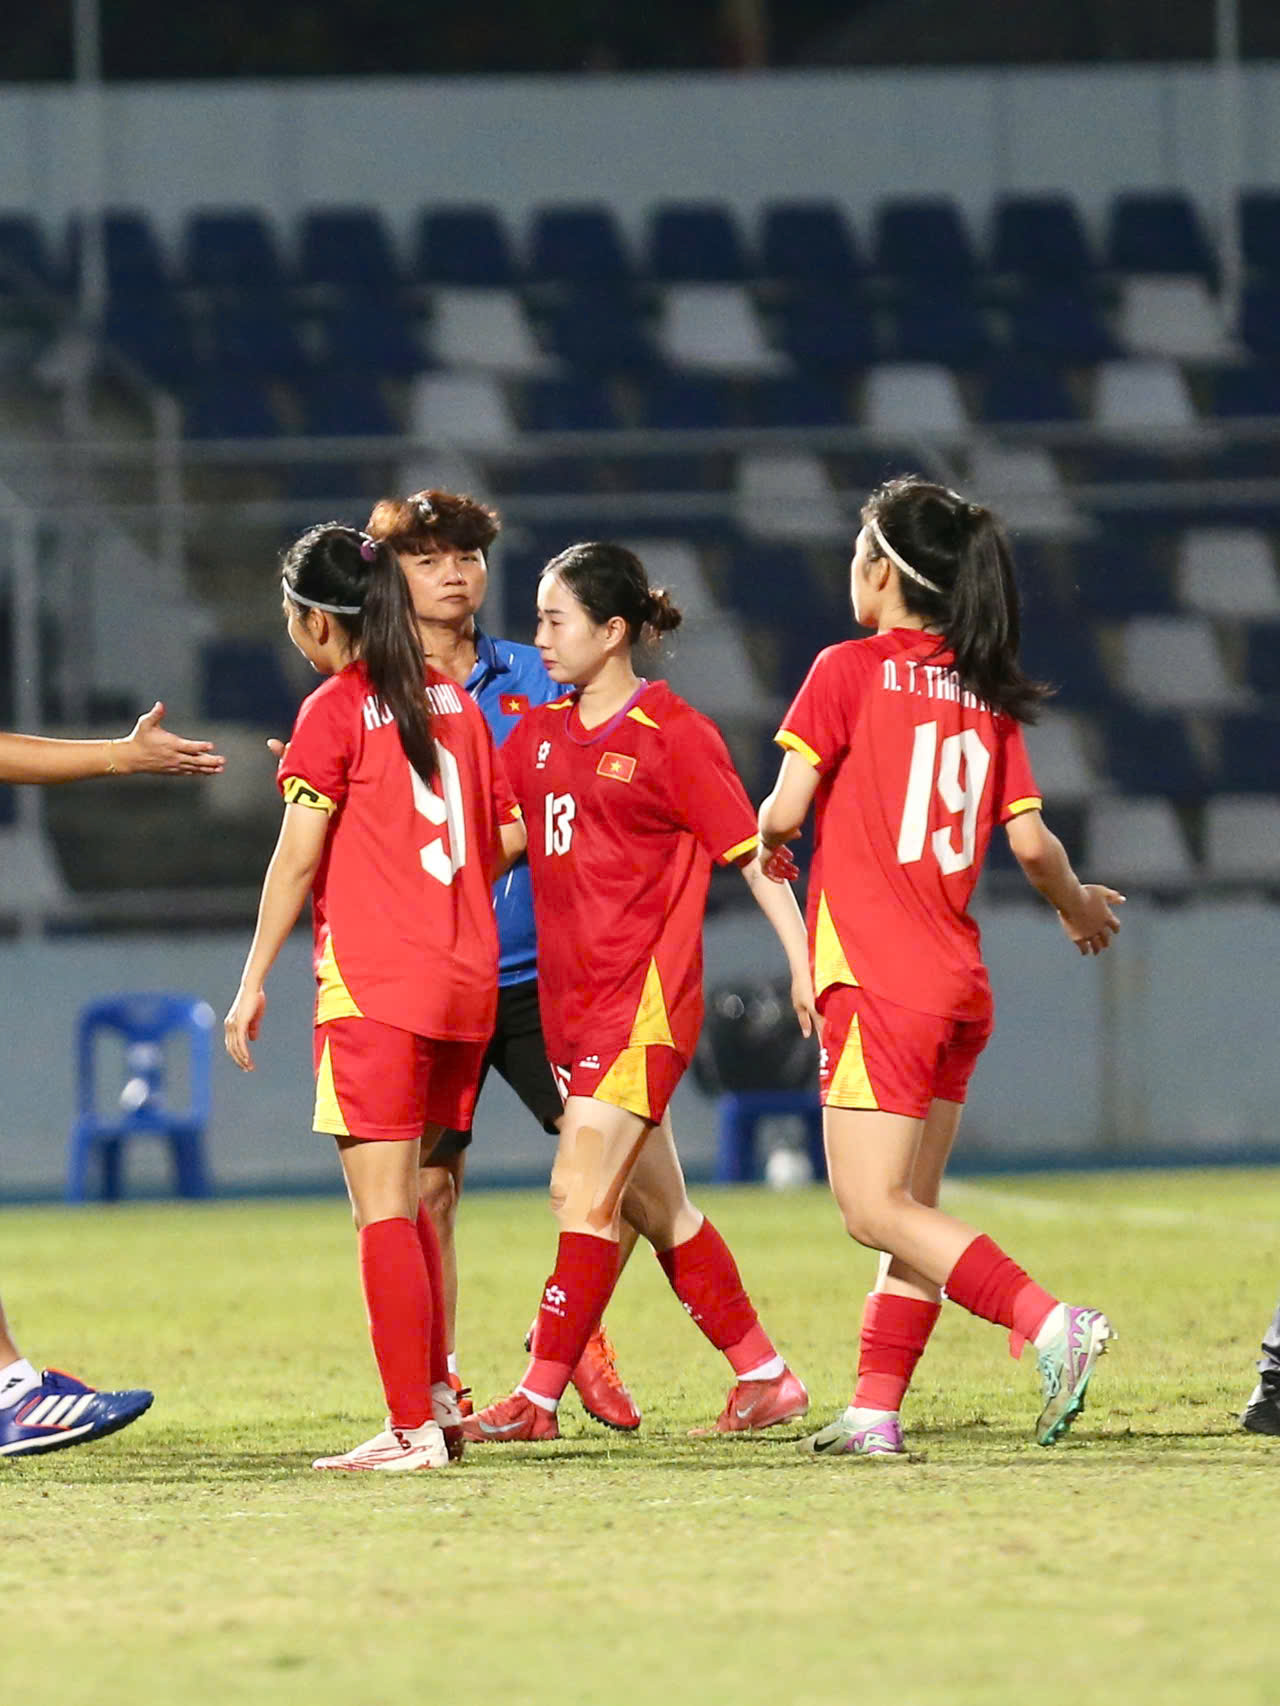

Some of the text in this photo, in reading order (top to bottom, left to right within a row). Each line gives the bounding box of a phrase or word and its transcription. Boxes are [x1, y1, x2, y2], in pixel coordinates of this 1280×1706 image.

[408, 738, 466, 886] 9
[545, 792, 576, 856] 13
[897, 720, 991, 876] 19
